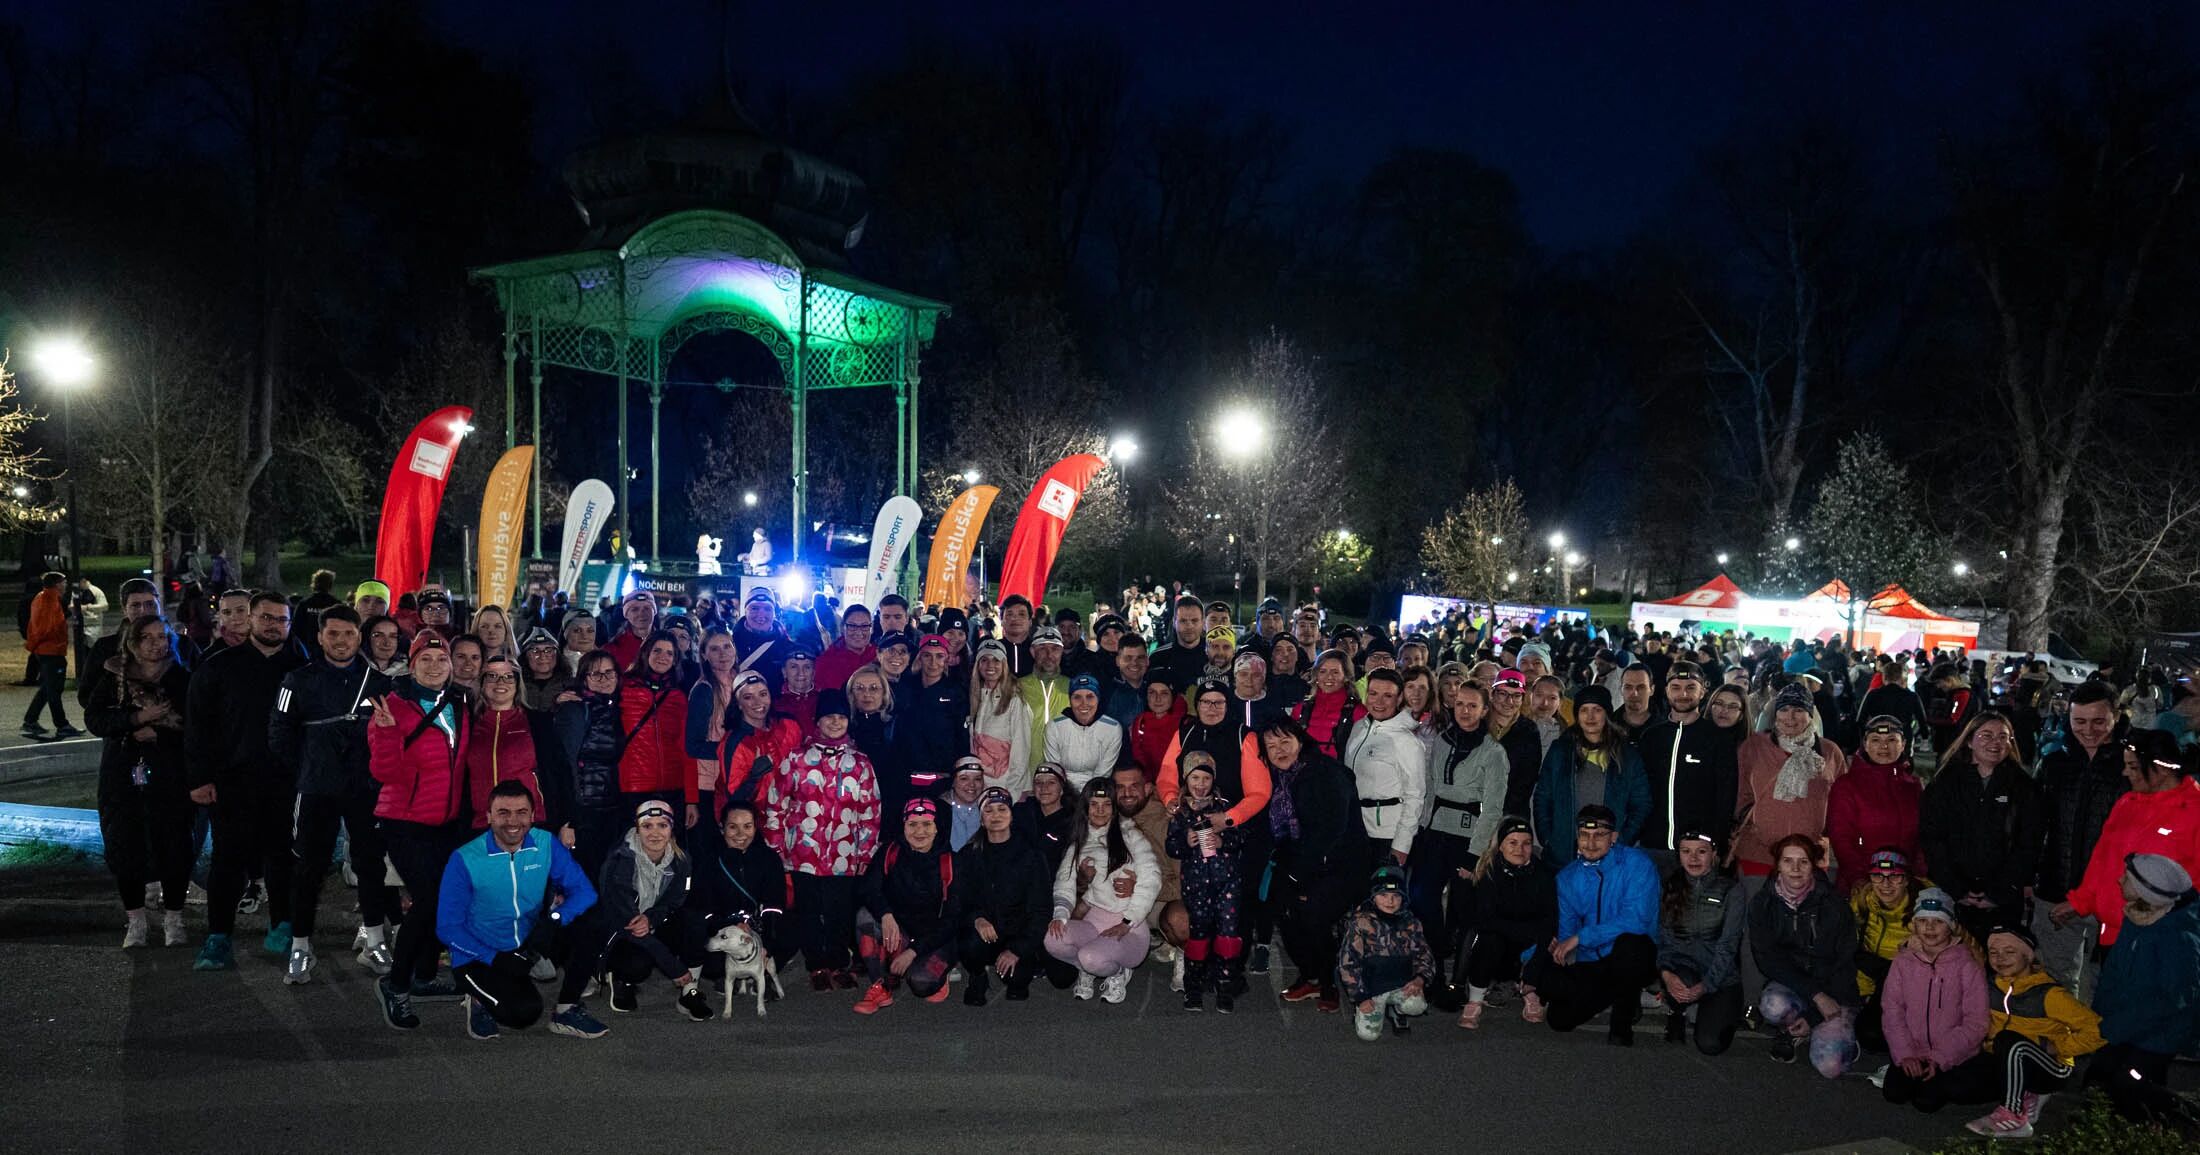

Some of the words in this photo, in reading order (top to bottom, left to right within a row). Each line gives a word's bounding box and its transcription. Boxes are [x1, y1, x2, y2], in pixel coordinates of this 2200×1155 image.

[572, 499, 597, 562] INTERSPORT
[878, 514, 904, 574] INTERSPORT
[943, 490, 980, 582] světluška
[638, 579, 666, 591] NOČNÍ
